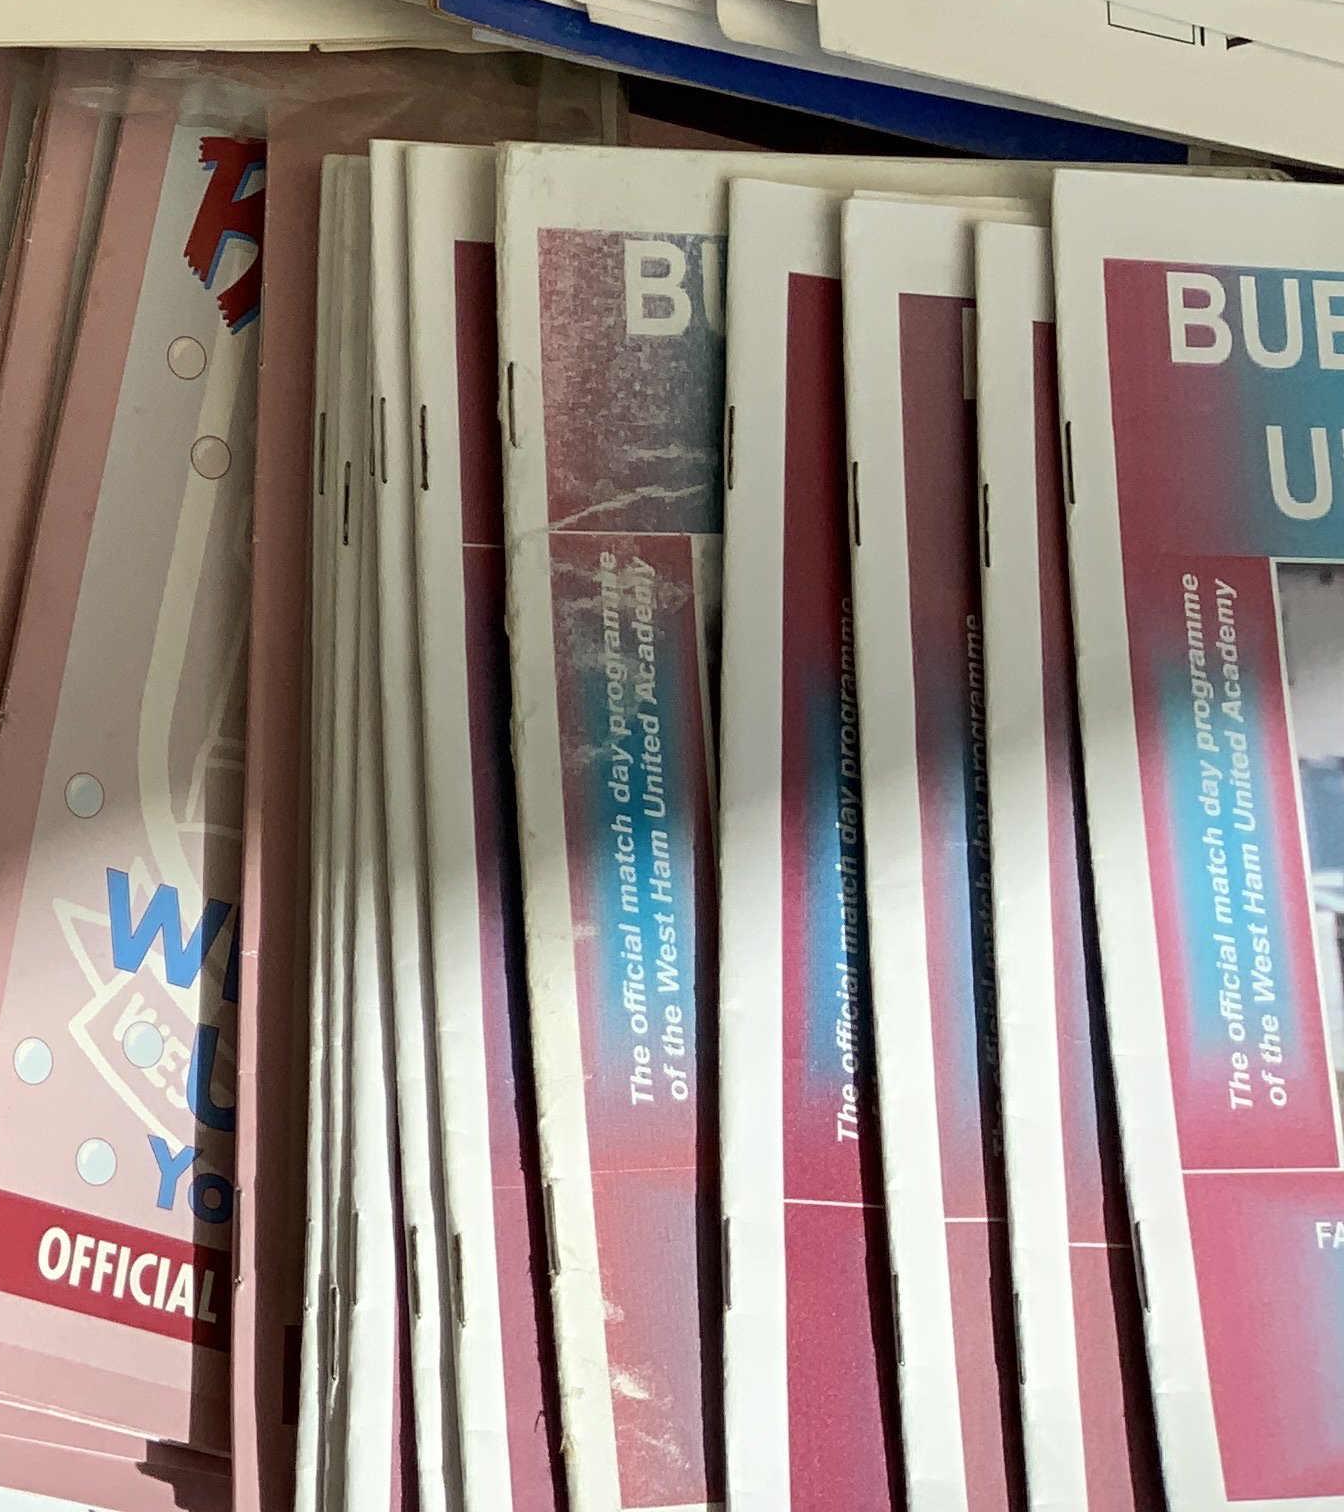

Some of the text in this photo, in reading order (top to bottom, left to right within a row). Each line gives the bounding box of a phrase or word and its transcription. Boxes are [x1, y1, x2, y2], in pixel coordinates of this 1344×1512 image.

[606, 751, 655, 1107] The official match day
[1182, 573, 1254, 1112] The official match day programme
[1215, 578, 1288, 1108] of the West Ham United Academy
[38, 1227, 194, 1318] OFFICIAL
